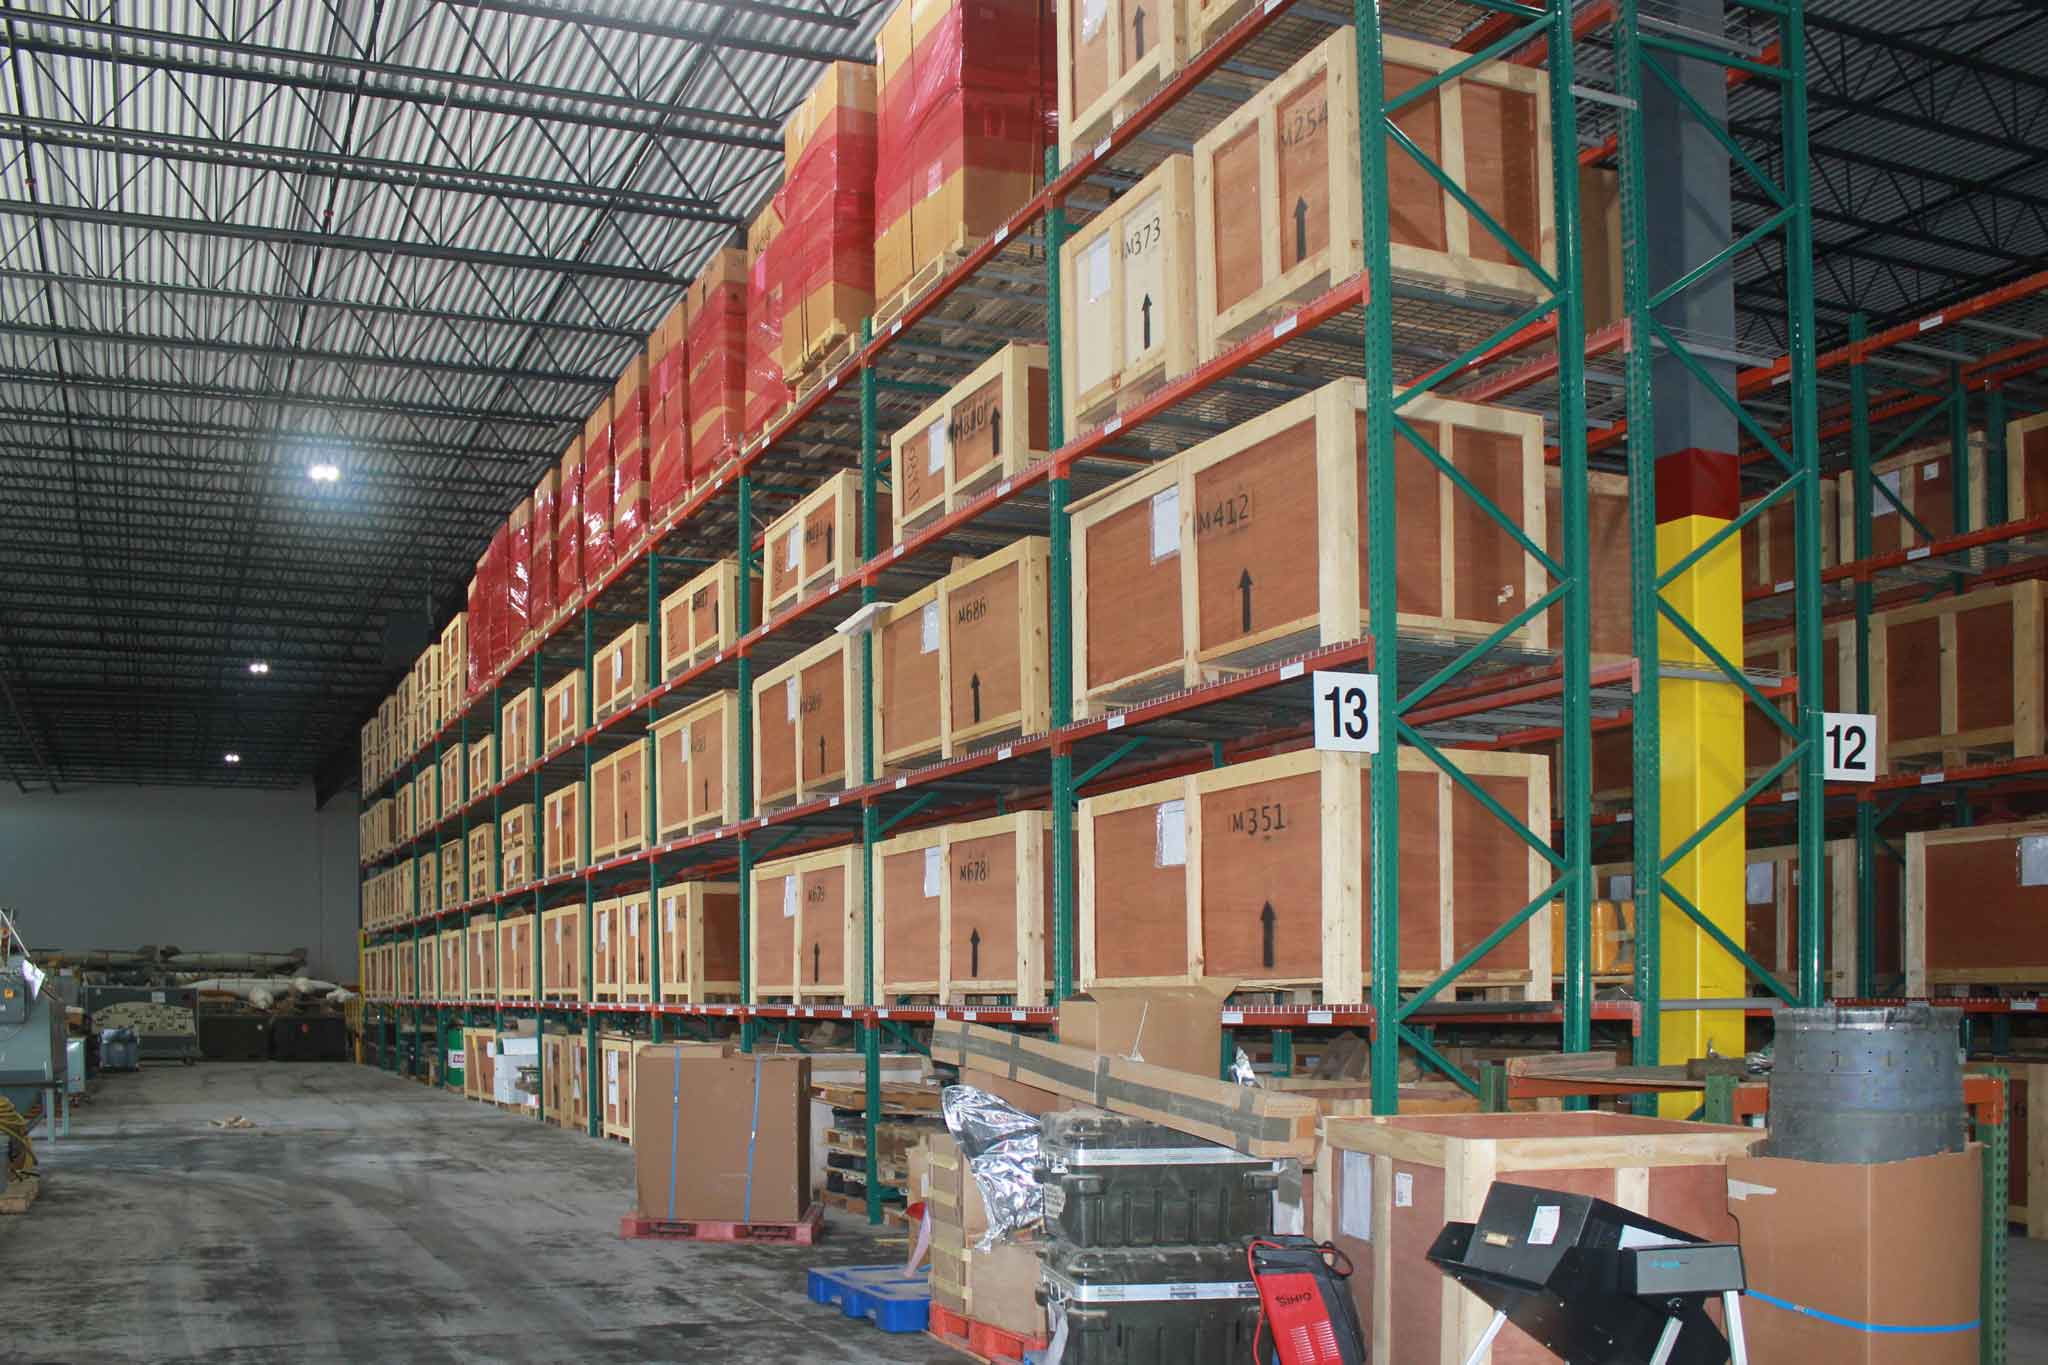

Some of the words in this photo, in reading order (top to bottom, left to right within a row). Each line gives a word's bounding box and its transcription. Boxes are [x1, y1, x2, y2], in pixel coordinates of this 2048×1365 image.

[1125, 216, 1161, 259] M373
[1199, 494, 1248, 530] M412
[1324, 686, 1369, 740] 13
[1825, 724, 1867, 770] 12
[1232, 803, 1286, 835] M351
